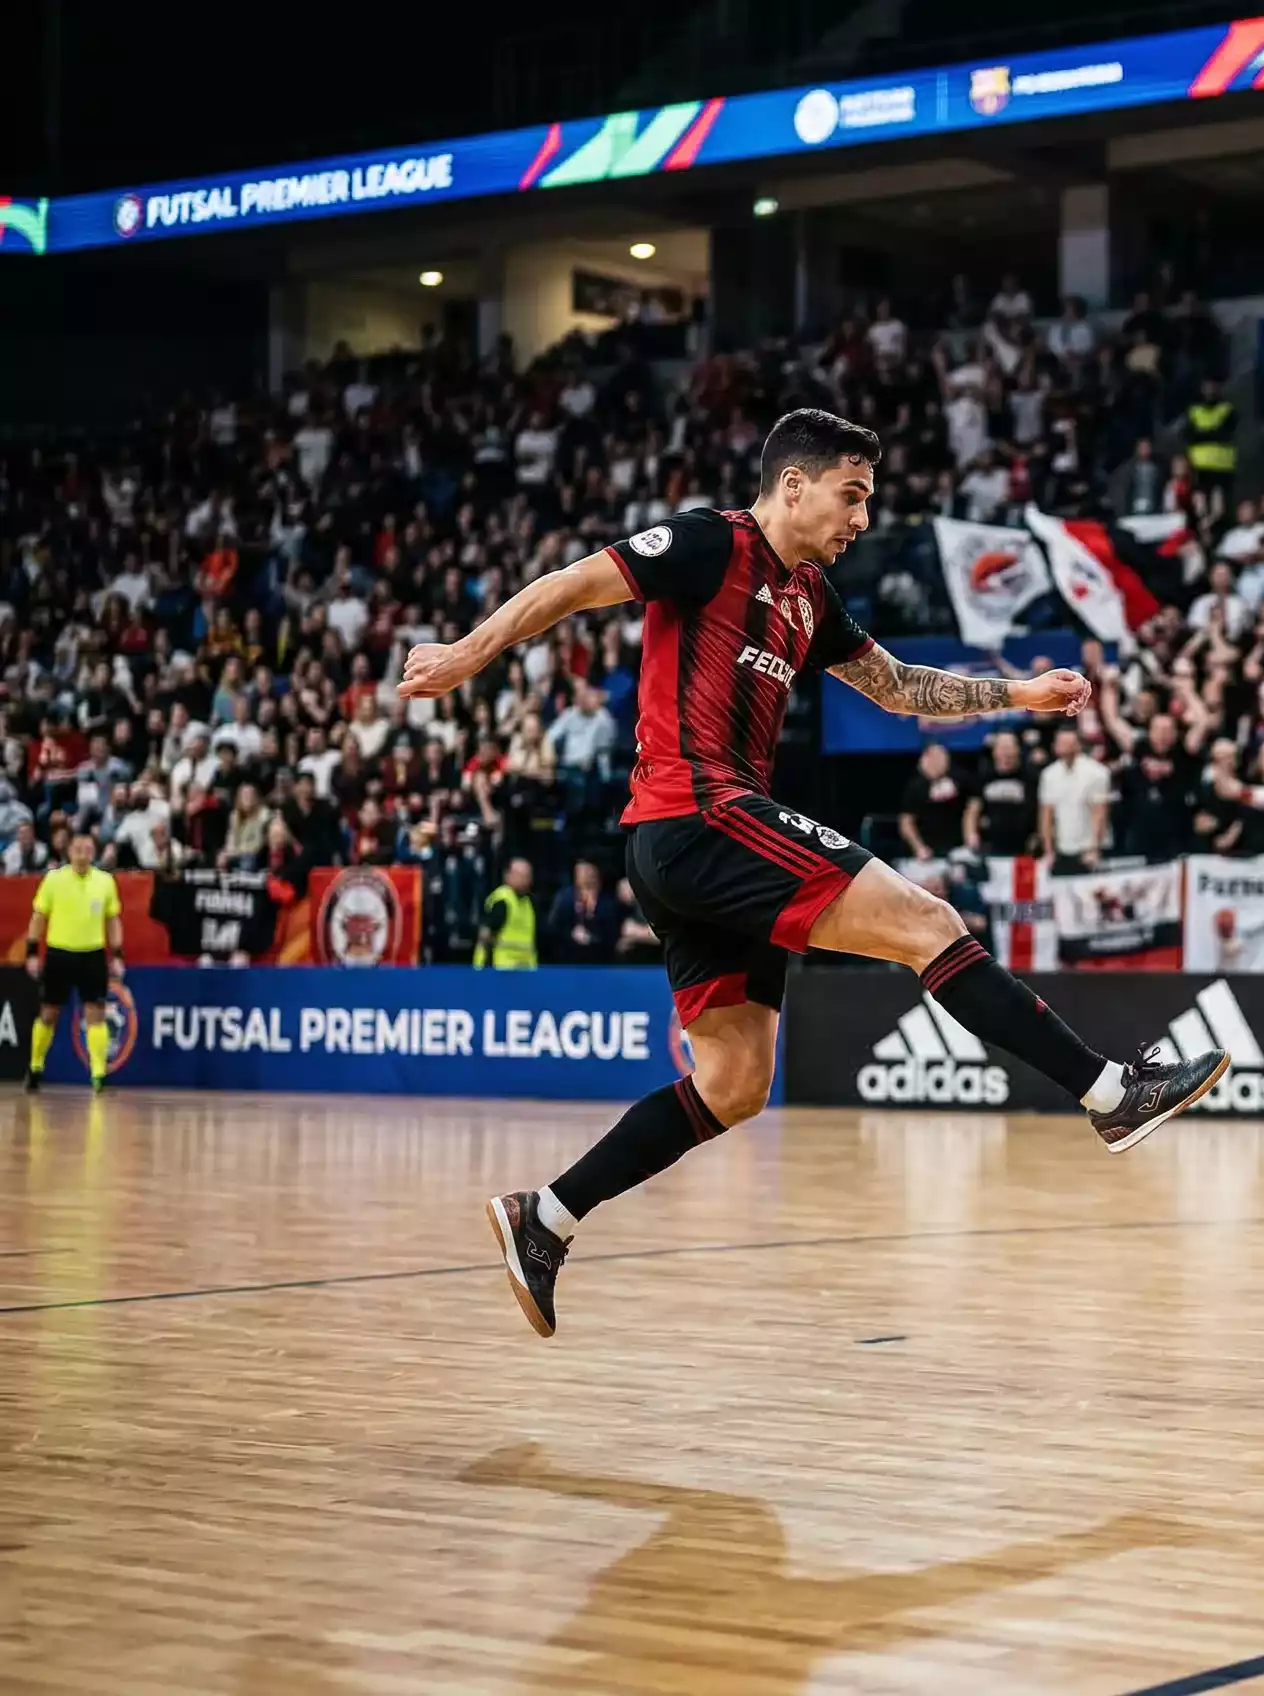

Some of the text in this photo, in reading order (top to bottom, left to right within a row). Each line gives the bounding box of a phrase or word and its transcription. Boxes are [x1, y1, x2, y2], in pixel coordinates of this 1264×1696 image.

[147, 154, 452, 228] FUTSAL PREMIER LEAGUE
[153, 1006, 650, 1060] FUTSAL PREMIER LEAGUE
[857, 1056, 1009, 1104] adidas
